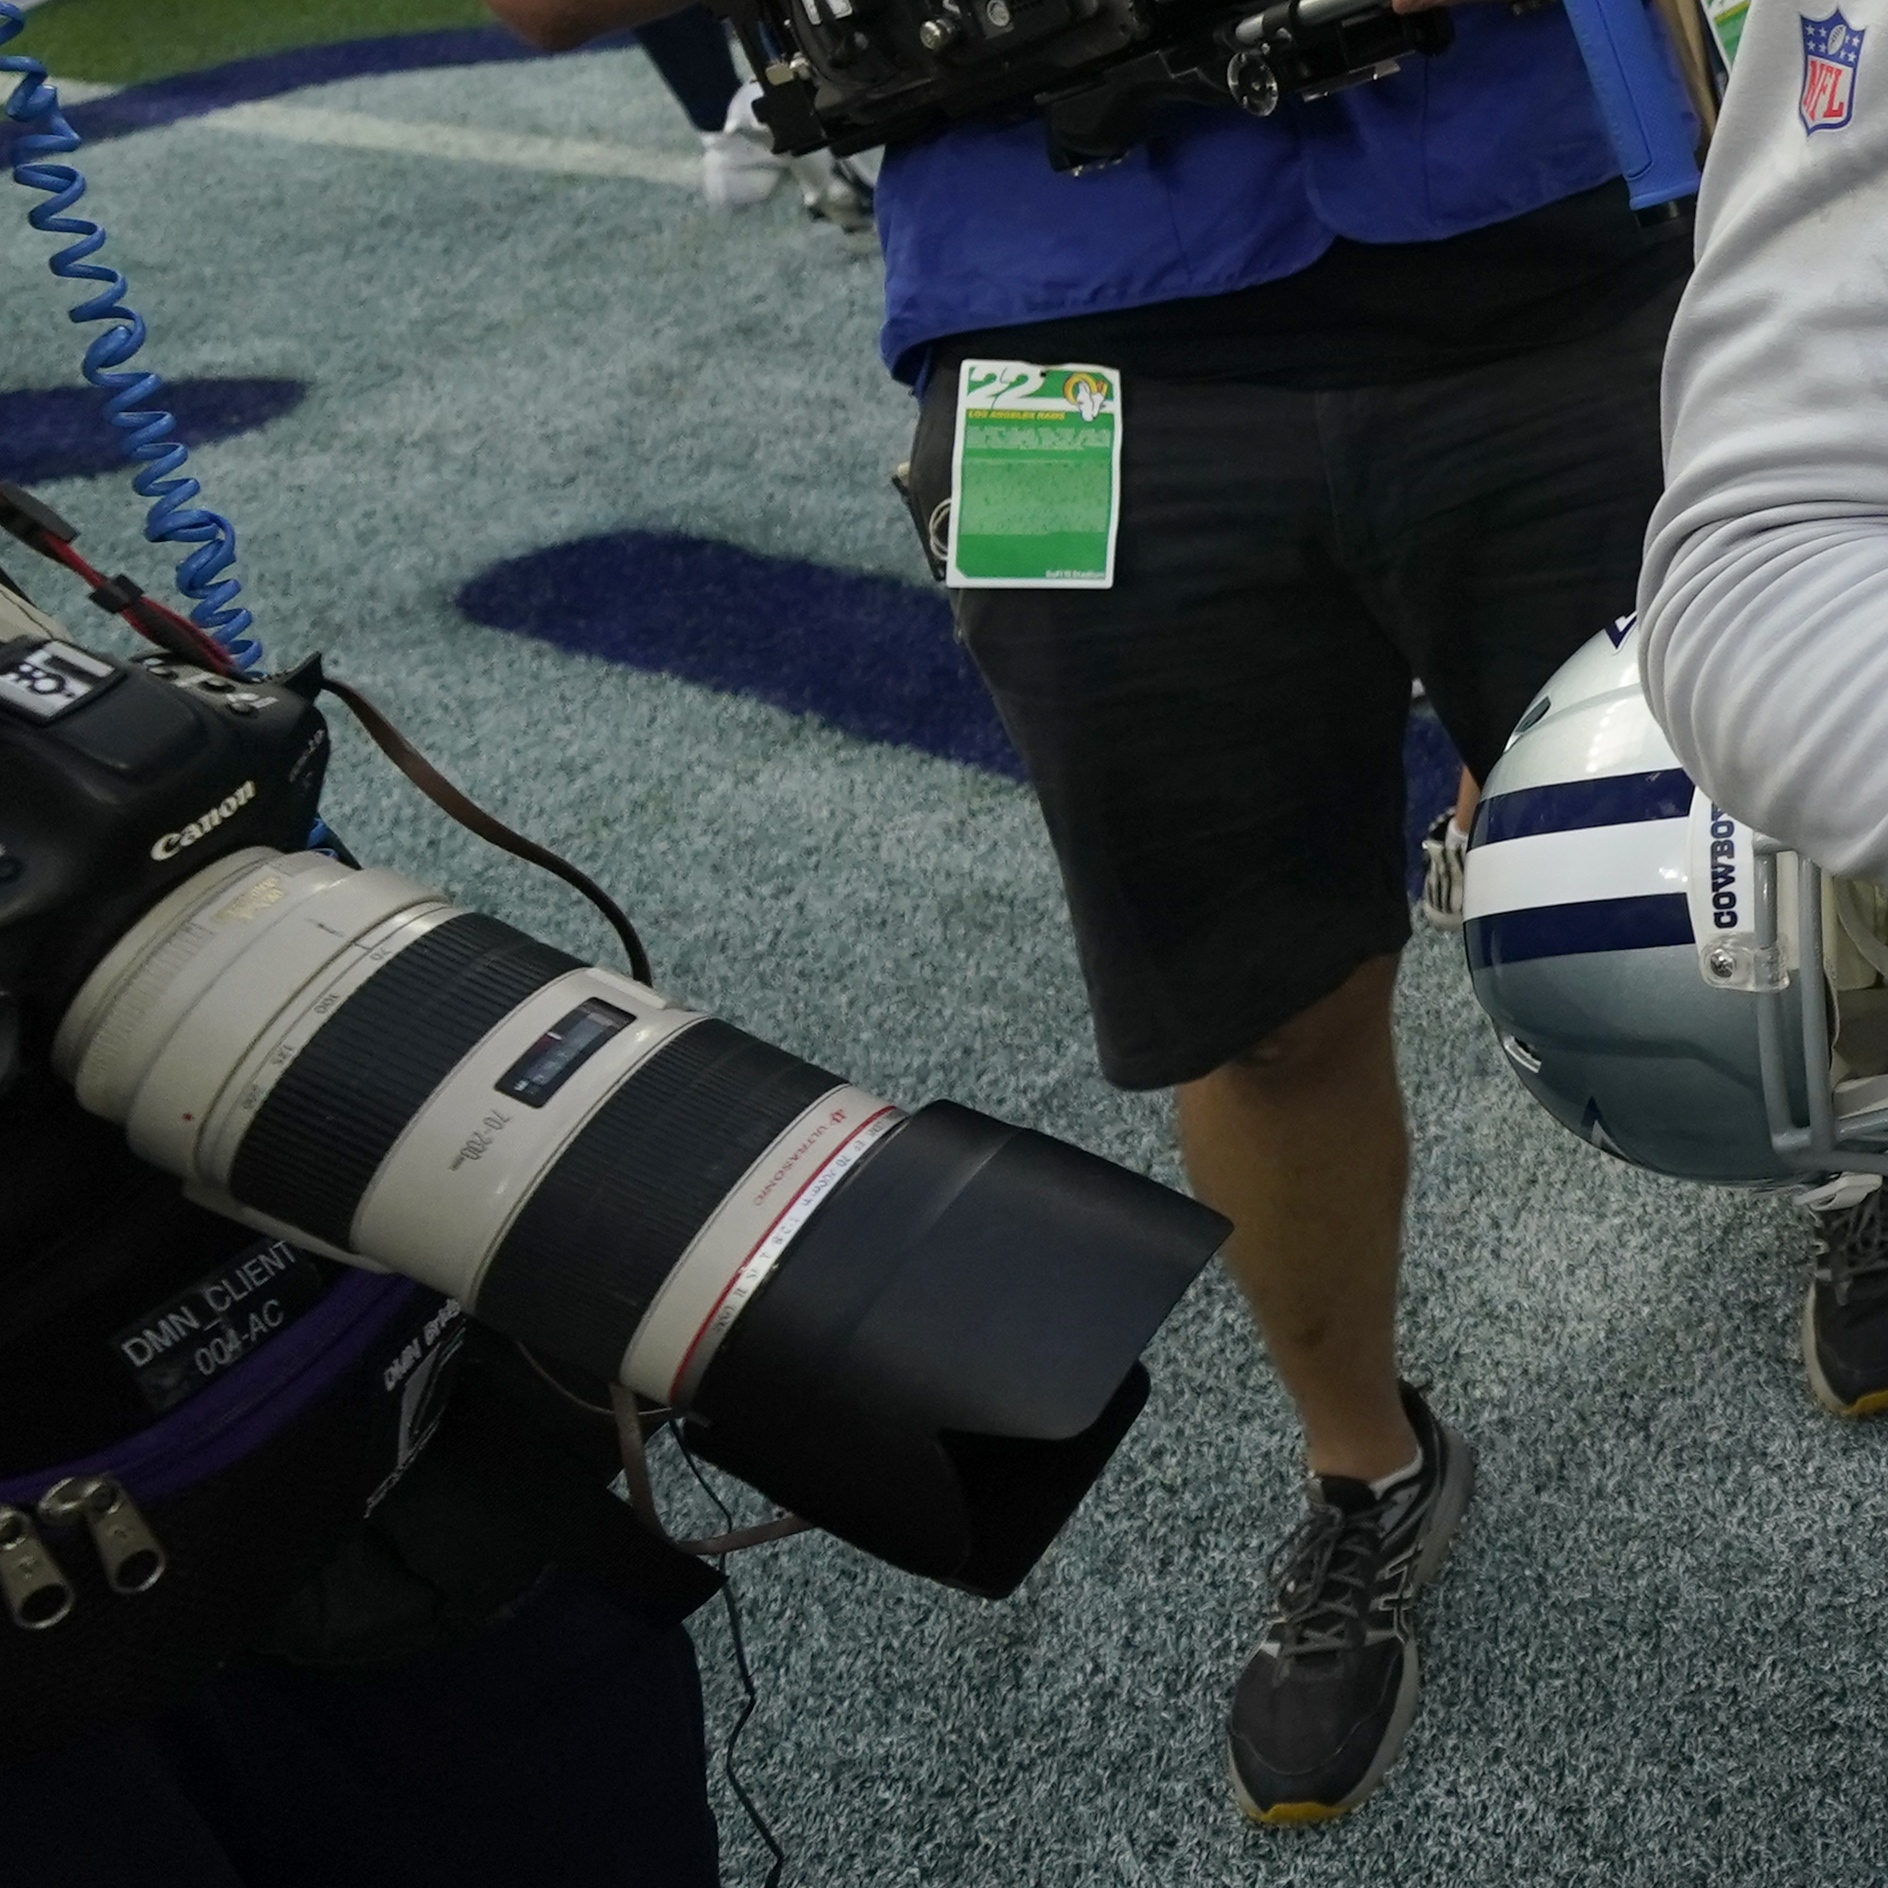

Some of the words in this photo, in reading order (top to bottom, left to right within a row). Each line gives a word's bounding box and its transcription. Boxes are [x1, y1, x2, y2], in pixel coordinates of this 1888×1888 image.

[1802, 58, 1846, 123] NFL
[967, 364, 1047, 410] 22
[968, 410, 988, 419] LOS
[150, 778, 257, 865] Canon
[313, 991, 343, 1017] 100
[750, 1118, 827, 1210] ULTRASONIC
[120, 1239, 299, 1369] DMN_CLIENT
[193, 1298, 285, 1379] 004-AC
